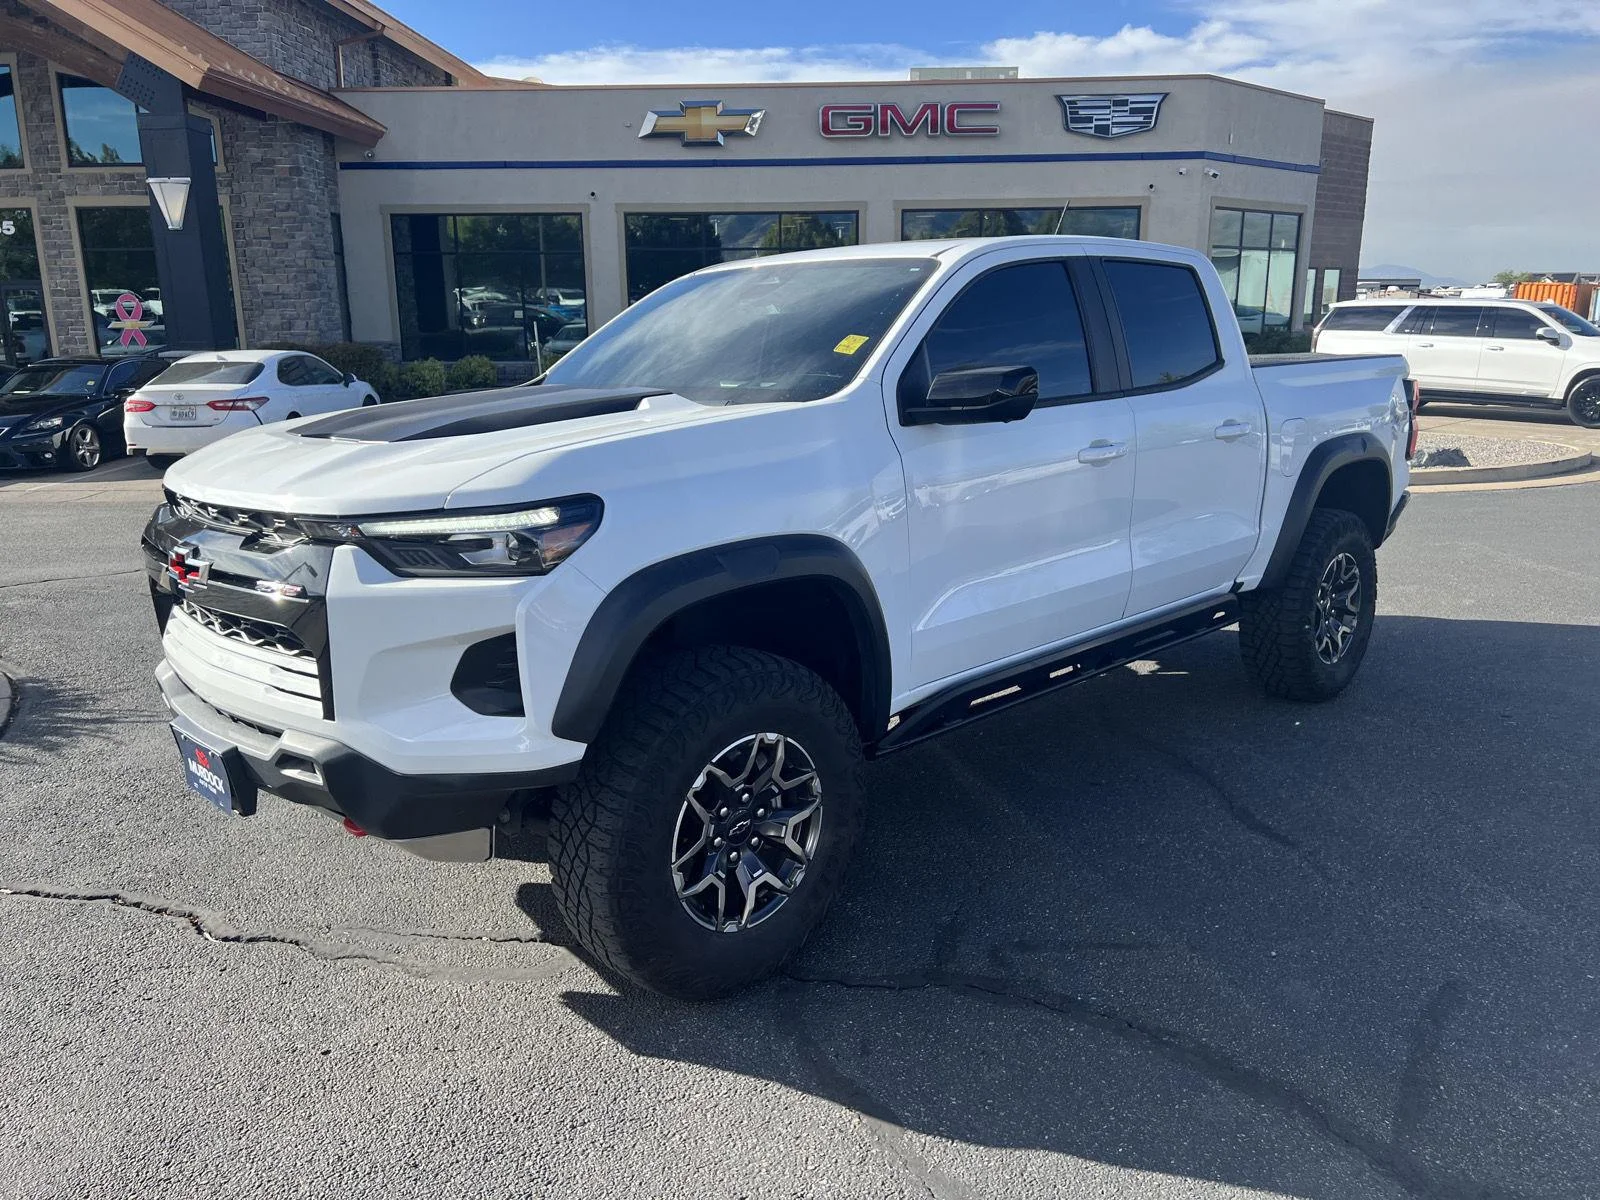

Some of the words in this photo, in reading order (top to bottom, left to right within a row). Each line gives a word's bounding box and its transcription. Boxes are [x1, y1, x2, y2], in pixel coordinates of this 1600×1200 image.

[819, 102, 1000, 138] GMC
[0, 220, 16, 235] 5
[187, 757, 226, 794] MURDOCK
